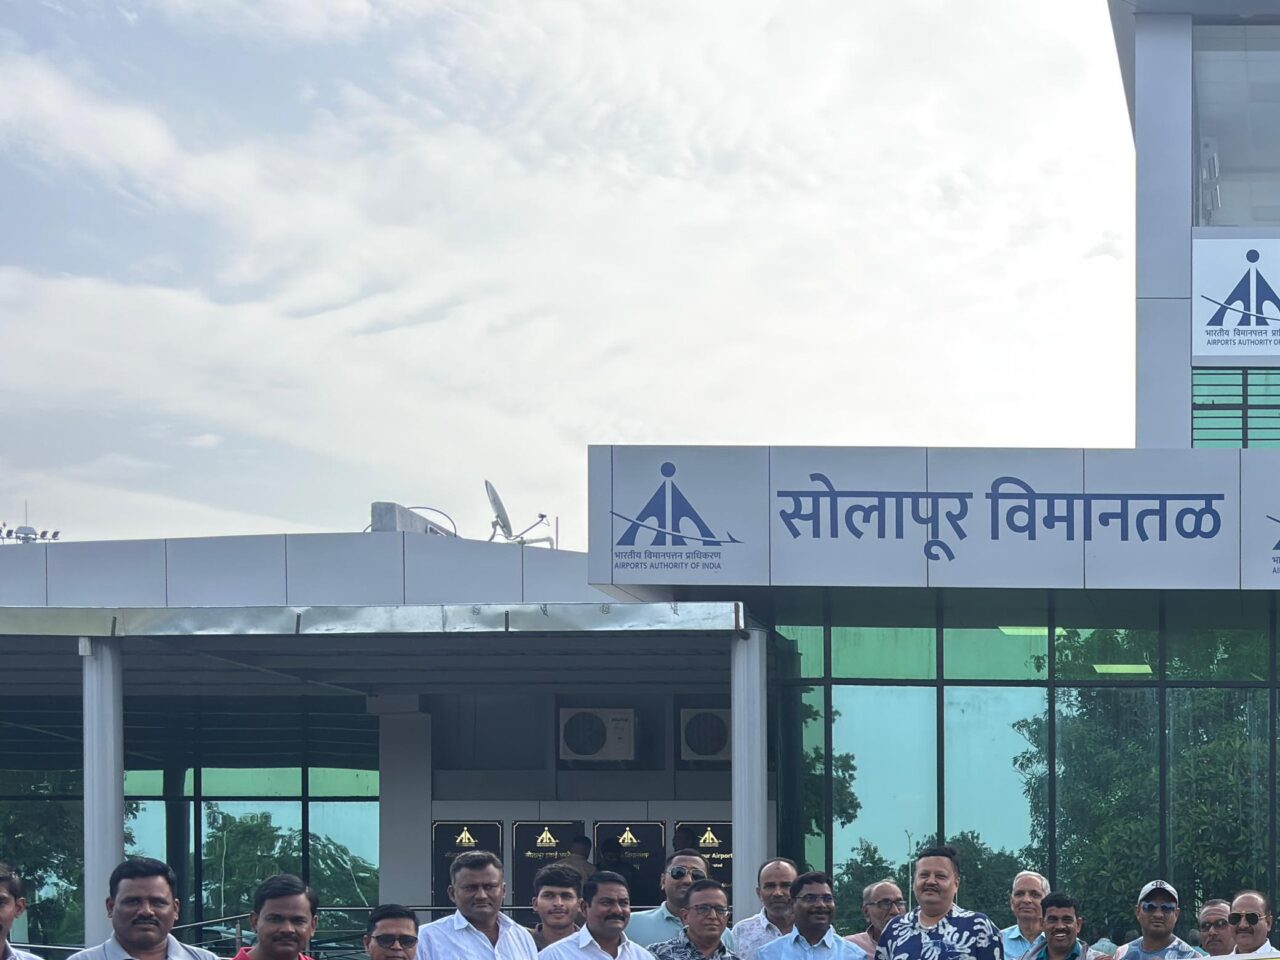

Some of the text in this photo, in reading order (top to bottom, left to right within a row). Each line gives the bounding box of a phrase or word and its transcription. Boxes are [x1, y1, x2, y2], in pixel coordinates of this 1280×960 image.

[1206, 328, 1230, 337] भारतीय
[777, 473, 1225, 562] सोलापूर विमानतळ
[614, 550, 642, 559] भारतीय
